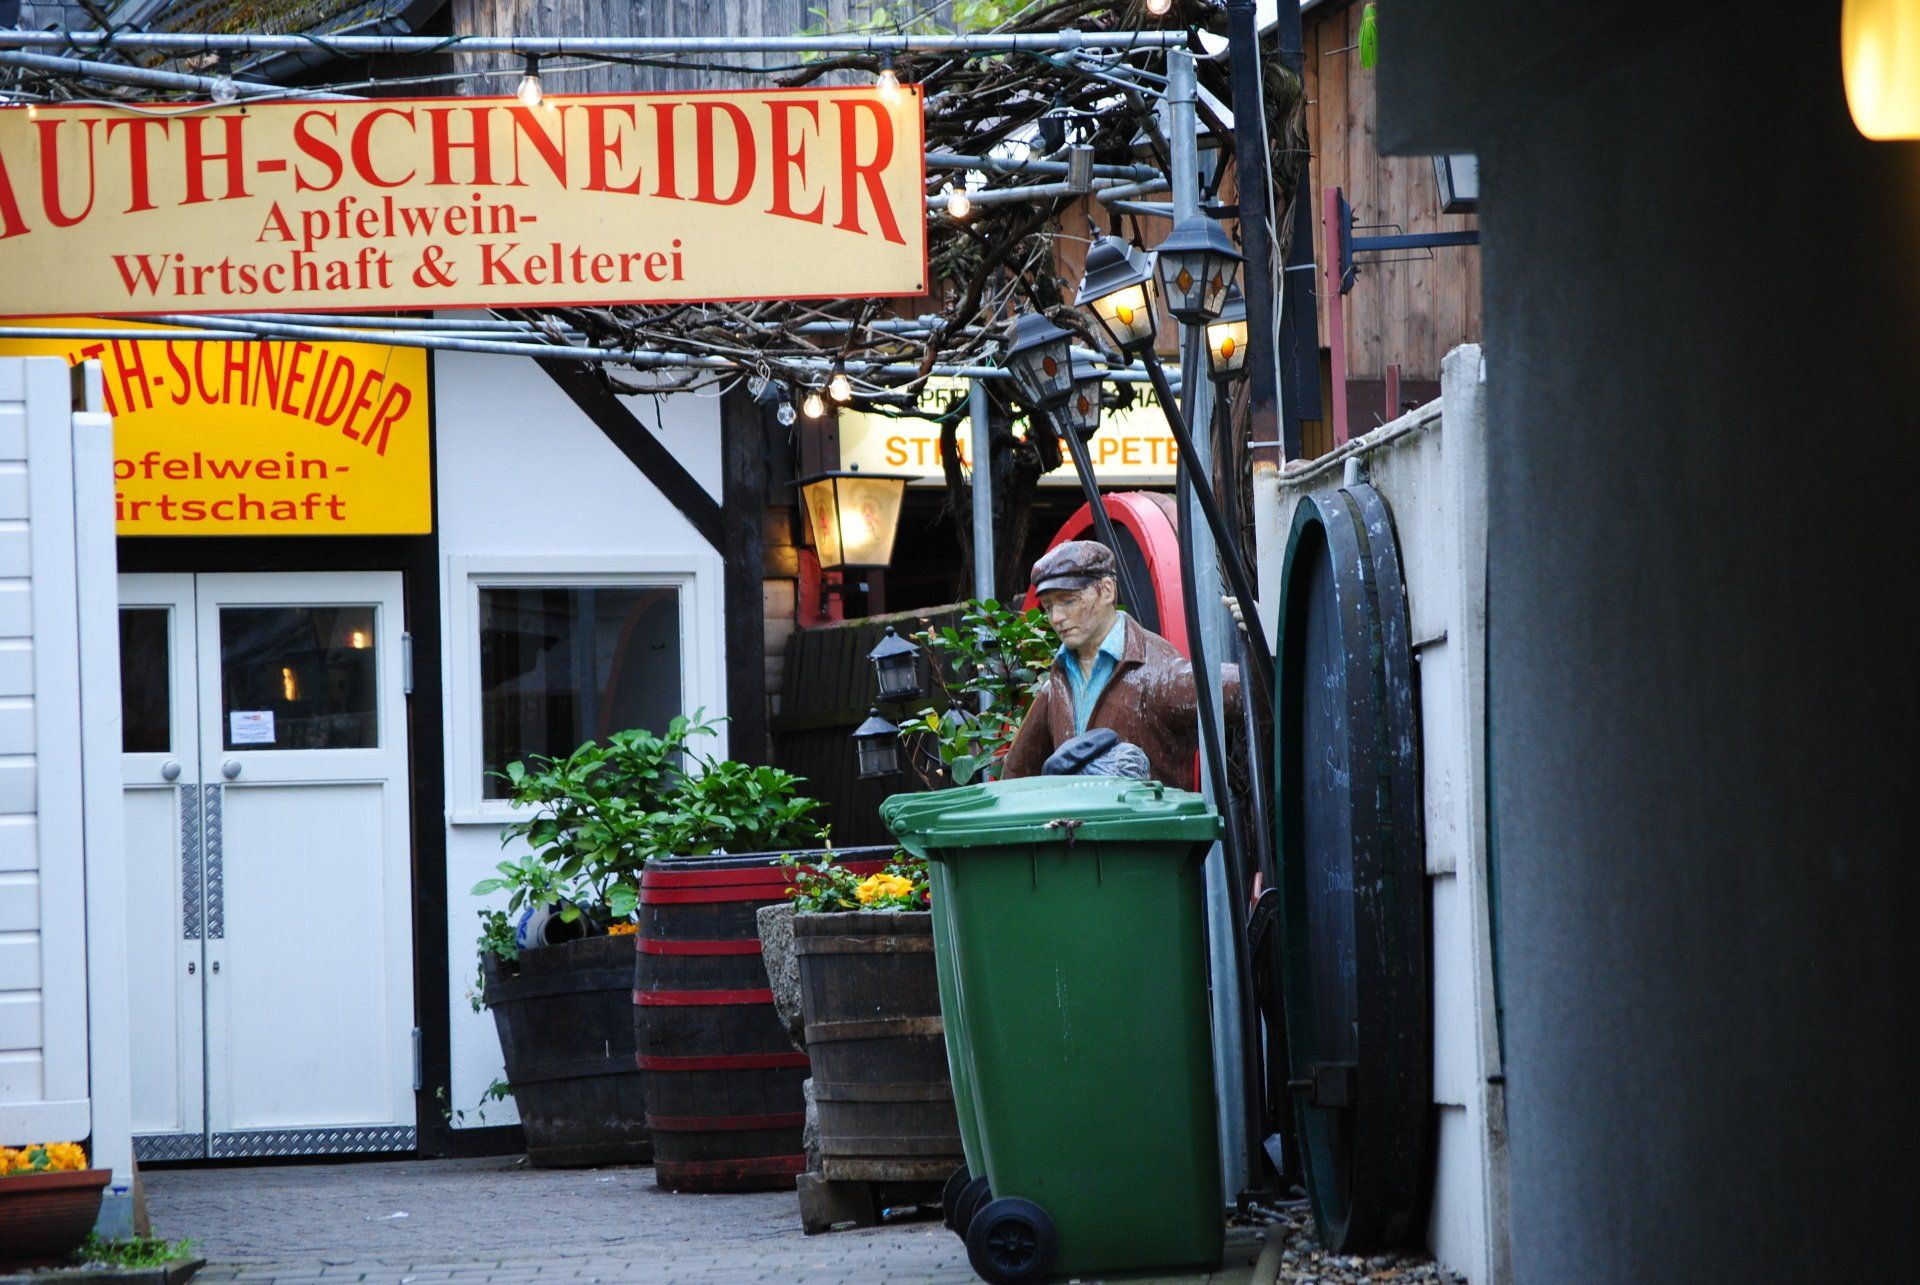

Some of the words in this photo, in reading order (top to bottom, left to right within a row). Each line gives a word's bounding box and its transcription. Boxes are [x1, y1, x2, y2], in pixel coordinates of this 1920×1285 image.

[255, 192, 538, 252] Apfelwein-
[112, 246, 393, 297] Wirtschaft
[412, 244, 457, 288] &
[478, 239, 685, 286] Kelterei
[70, 339, 412, 456] TH-SCHNEIDER
[115, 493, 346, 521] irtschaft
